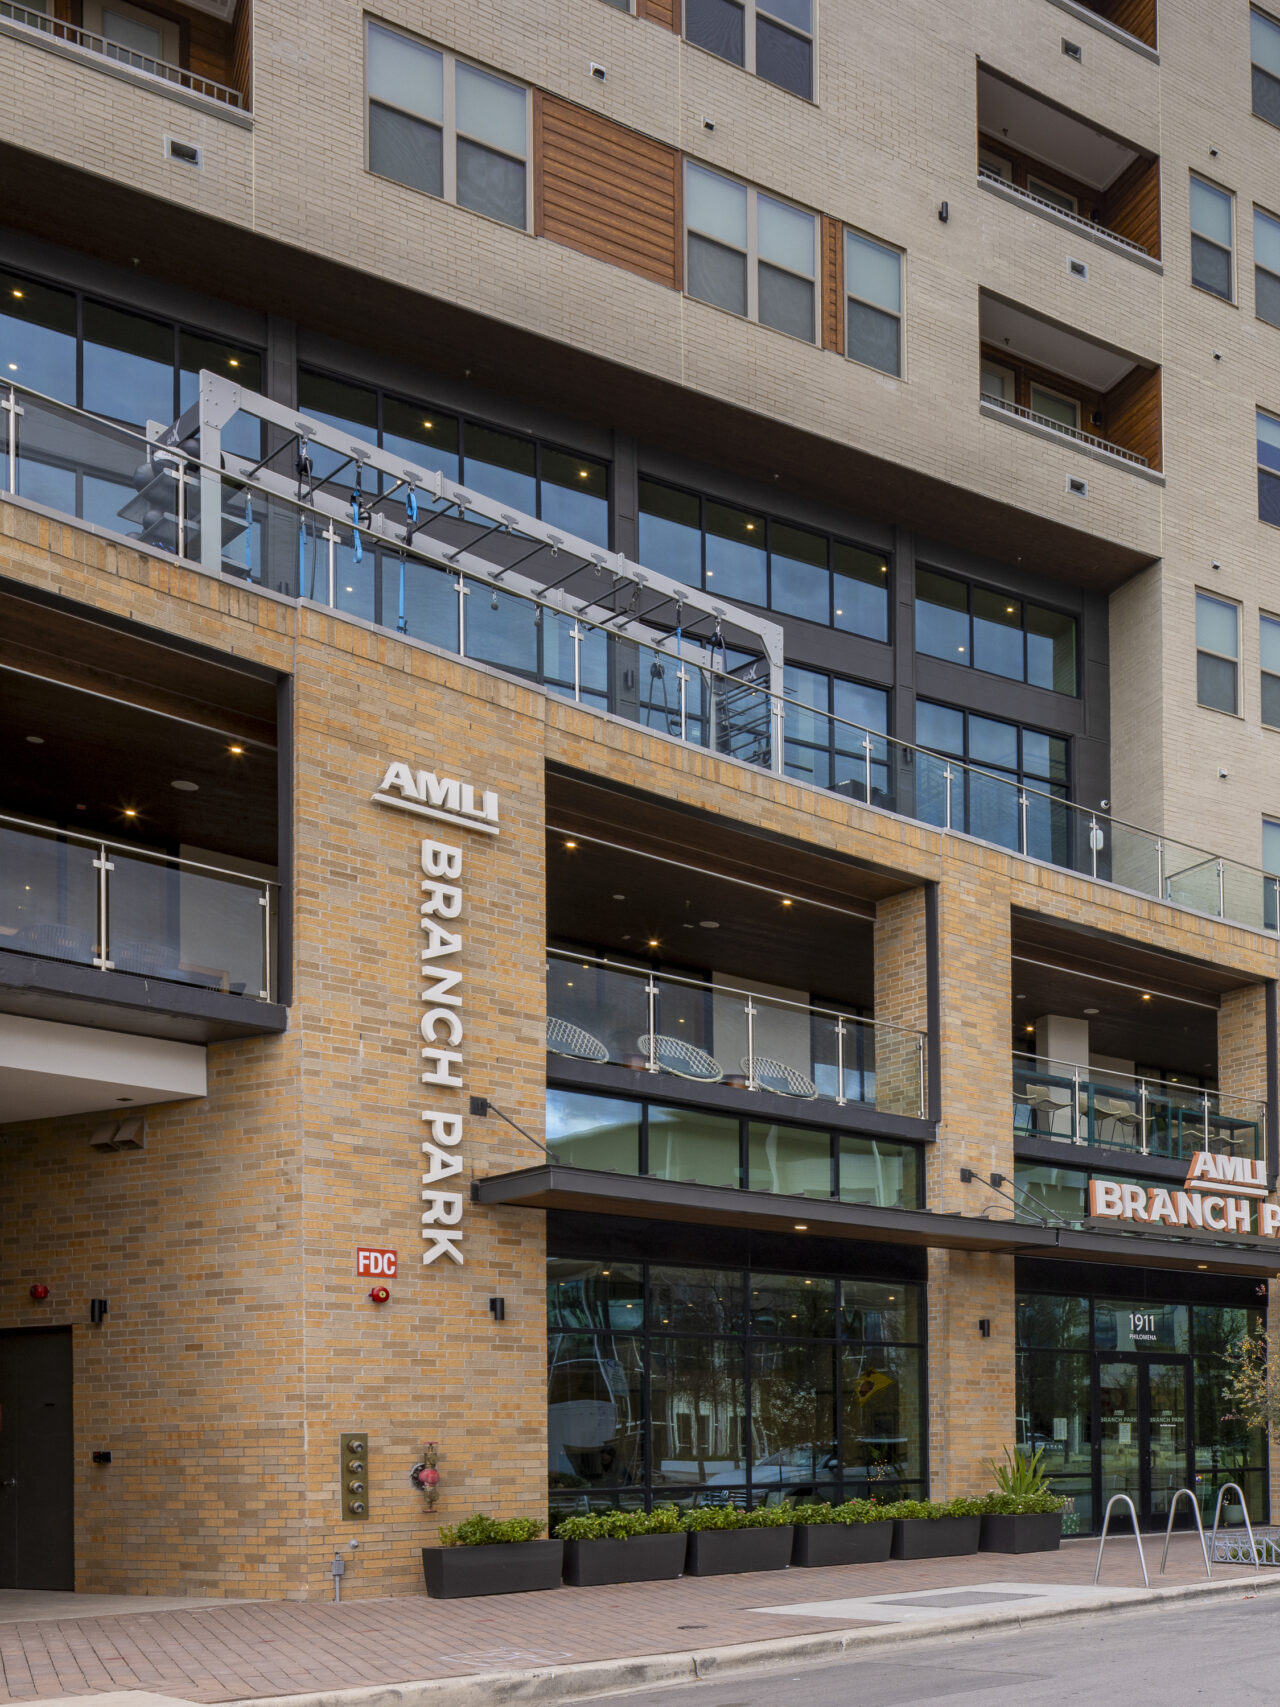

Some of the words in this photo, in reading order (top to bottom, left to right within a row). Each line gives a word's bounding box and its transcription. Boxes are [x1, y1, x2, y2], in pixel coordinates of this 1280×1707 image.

[376, 762, 498, 823] AMLI
[421, 838, 463, 1088] BRANCH
[421, 1111, 464, 1266] PARK
[1188, 1151, 1268, 1187] AMLI
[1089, 1179, 1250, 1233] BRANCH
[358, 1251, 396, 1275] FDC
[1129, 1313, 1155, 1331] 1911
[1129, 1333, 1157, 1341] PHILOMENA
